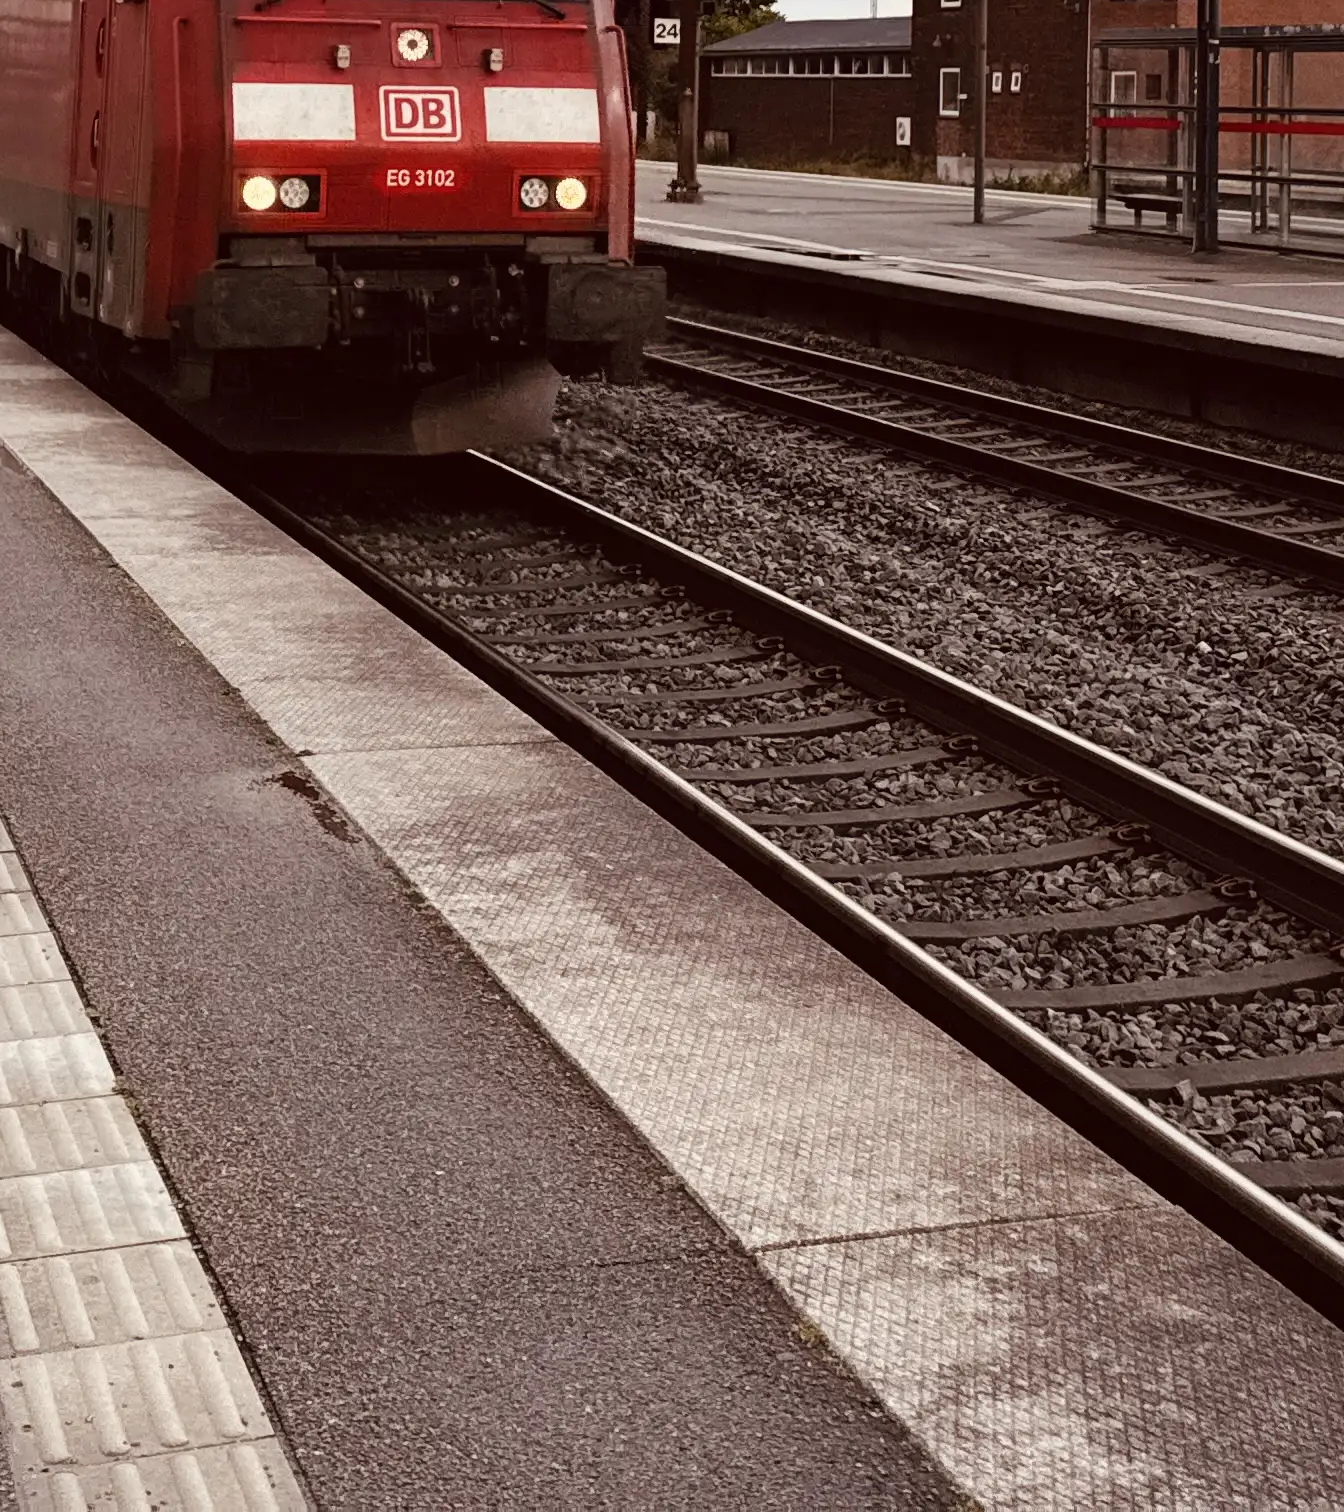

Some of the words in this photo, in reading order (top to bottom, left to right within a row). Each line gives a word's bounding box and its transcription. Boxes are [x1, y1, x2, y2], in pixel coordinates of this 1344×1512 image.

[656, 23, 680, 38] 24
[394, 97, 447, 129] DB
[387, 169, 411, 186] EG
[415, 169, 455, 187] 3102
